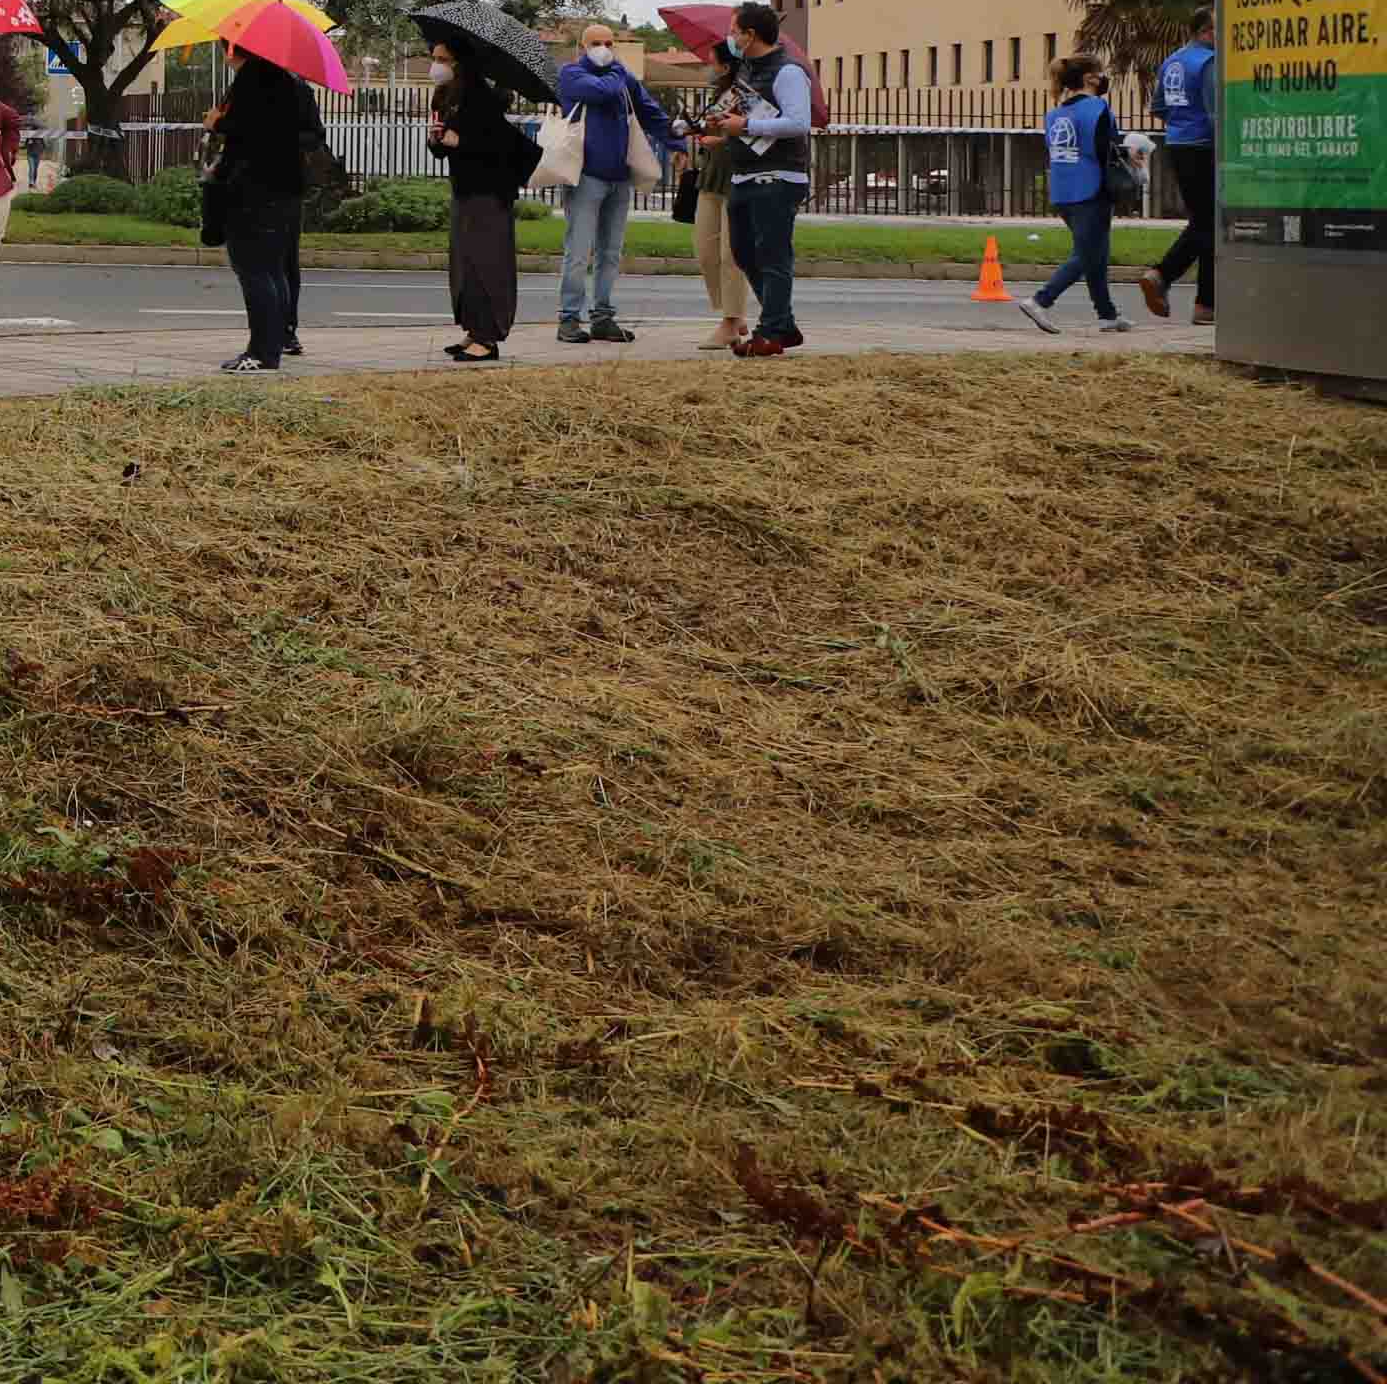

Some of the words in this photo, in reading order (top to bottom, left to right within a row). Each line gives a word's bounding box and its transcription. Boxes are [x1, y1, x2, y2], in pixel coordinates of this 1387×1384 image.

[1232, 16, 1309, 52] RESPIRAR
[1317, 12, 1378, 46] AIRE,
[1253, 63, 1274, 93] NO
[1281, 59, 1337, 92] HUMO
